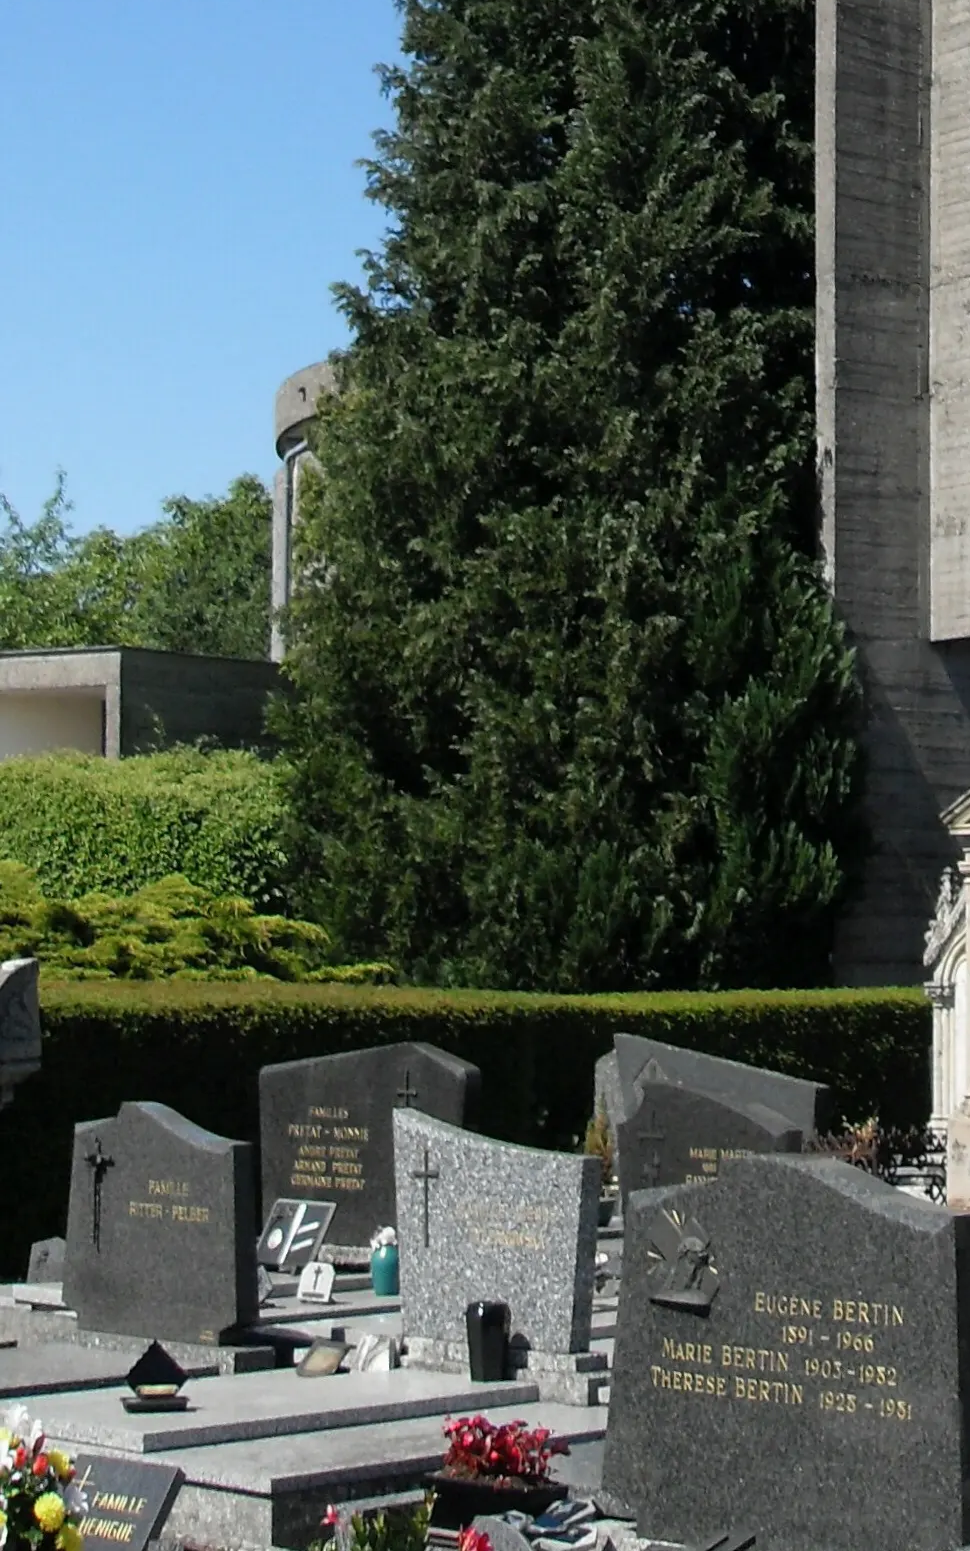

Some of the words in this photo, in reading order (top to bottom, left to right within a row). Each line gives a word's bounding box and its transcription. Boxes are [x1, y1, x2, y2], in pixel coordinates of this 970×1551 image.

[833, 1298, 904, 1326] BERTIN
[662, 1337, 712, 1364] MARIE
[722, 1344, 789, 1372] BERTIN
[837, 1331, 874, 1352] 1966
[651, 1365, 726, 1396] THERESE
[735, 1375, 804, 1404] BERTIN
[92, 1491, 148, 1515] FAMILLE
